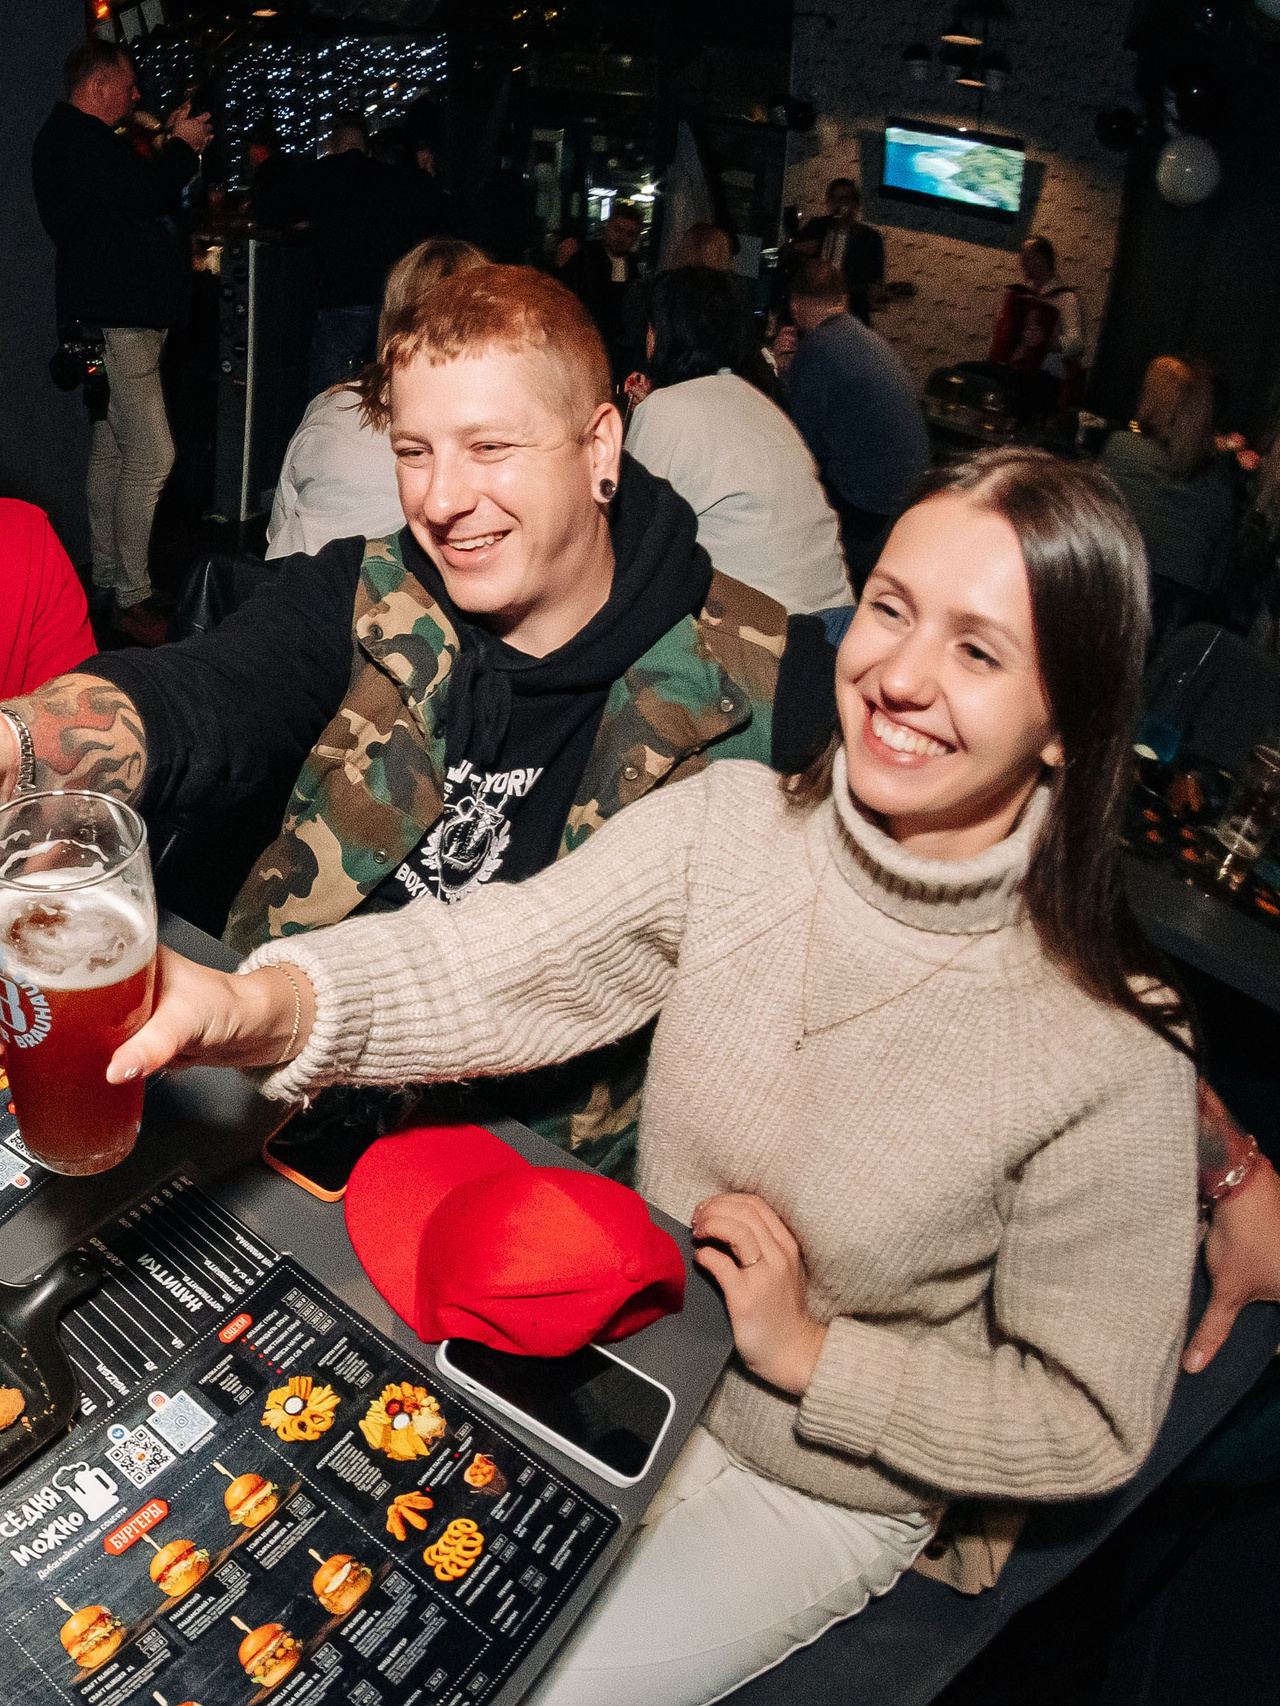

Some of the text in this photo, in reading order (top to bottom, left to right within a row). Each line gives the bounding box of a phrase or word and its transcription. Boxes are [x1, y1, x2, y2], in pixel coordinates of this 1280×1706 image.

[137, 1254, 204, 1313] НАПИТКИ
[222, 1316, 248, 1340] СНЕКИ
[108, 1502, 164, 1550] БУРГЕРЫ
